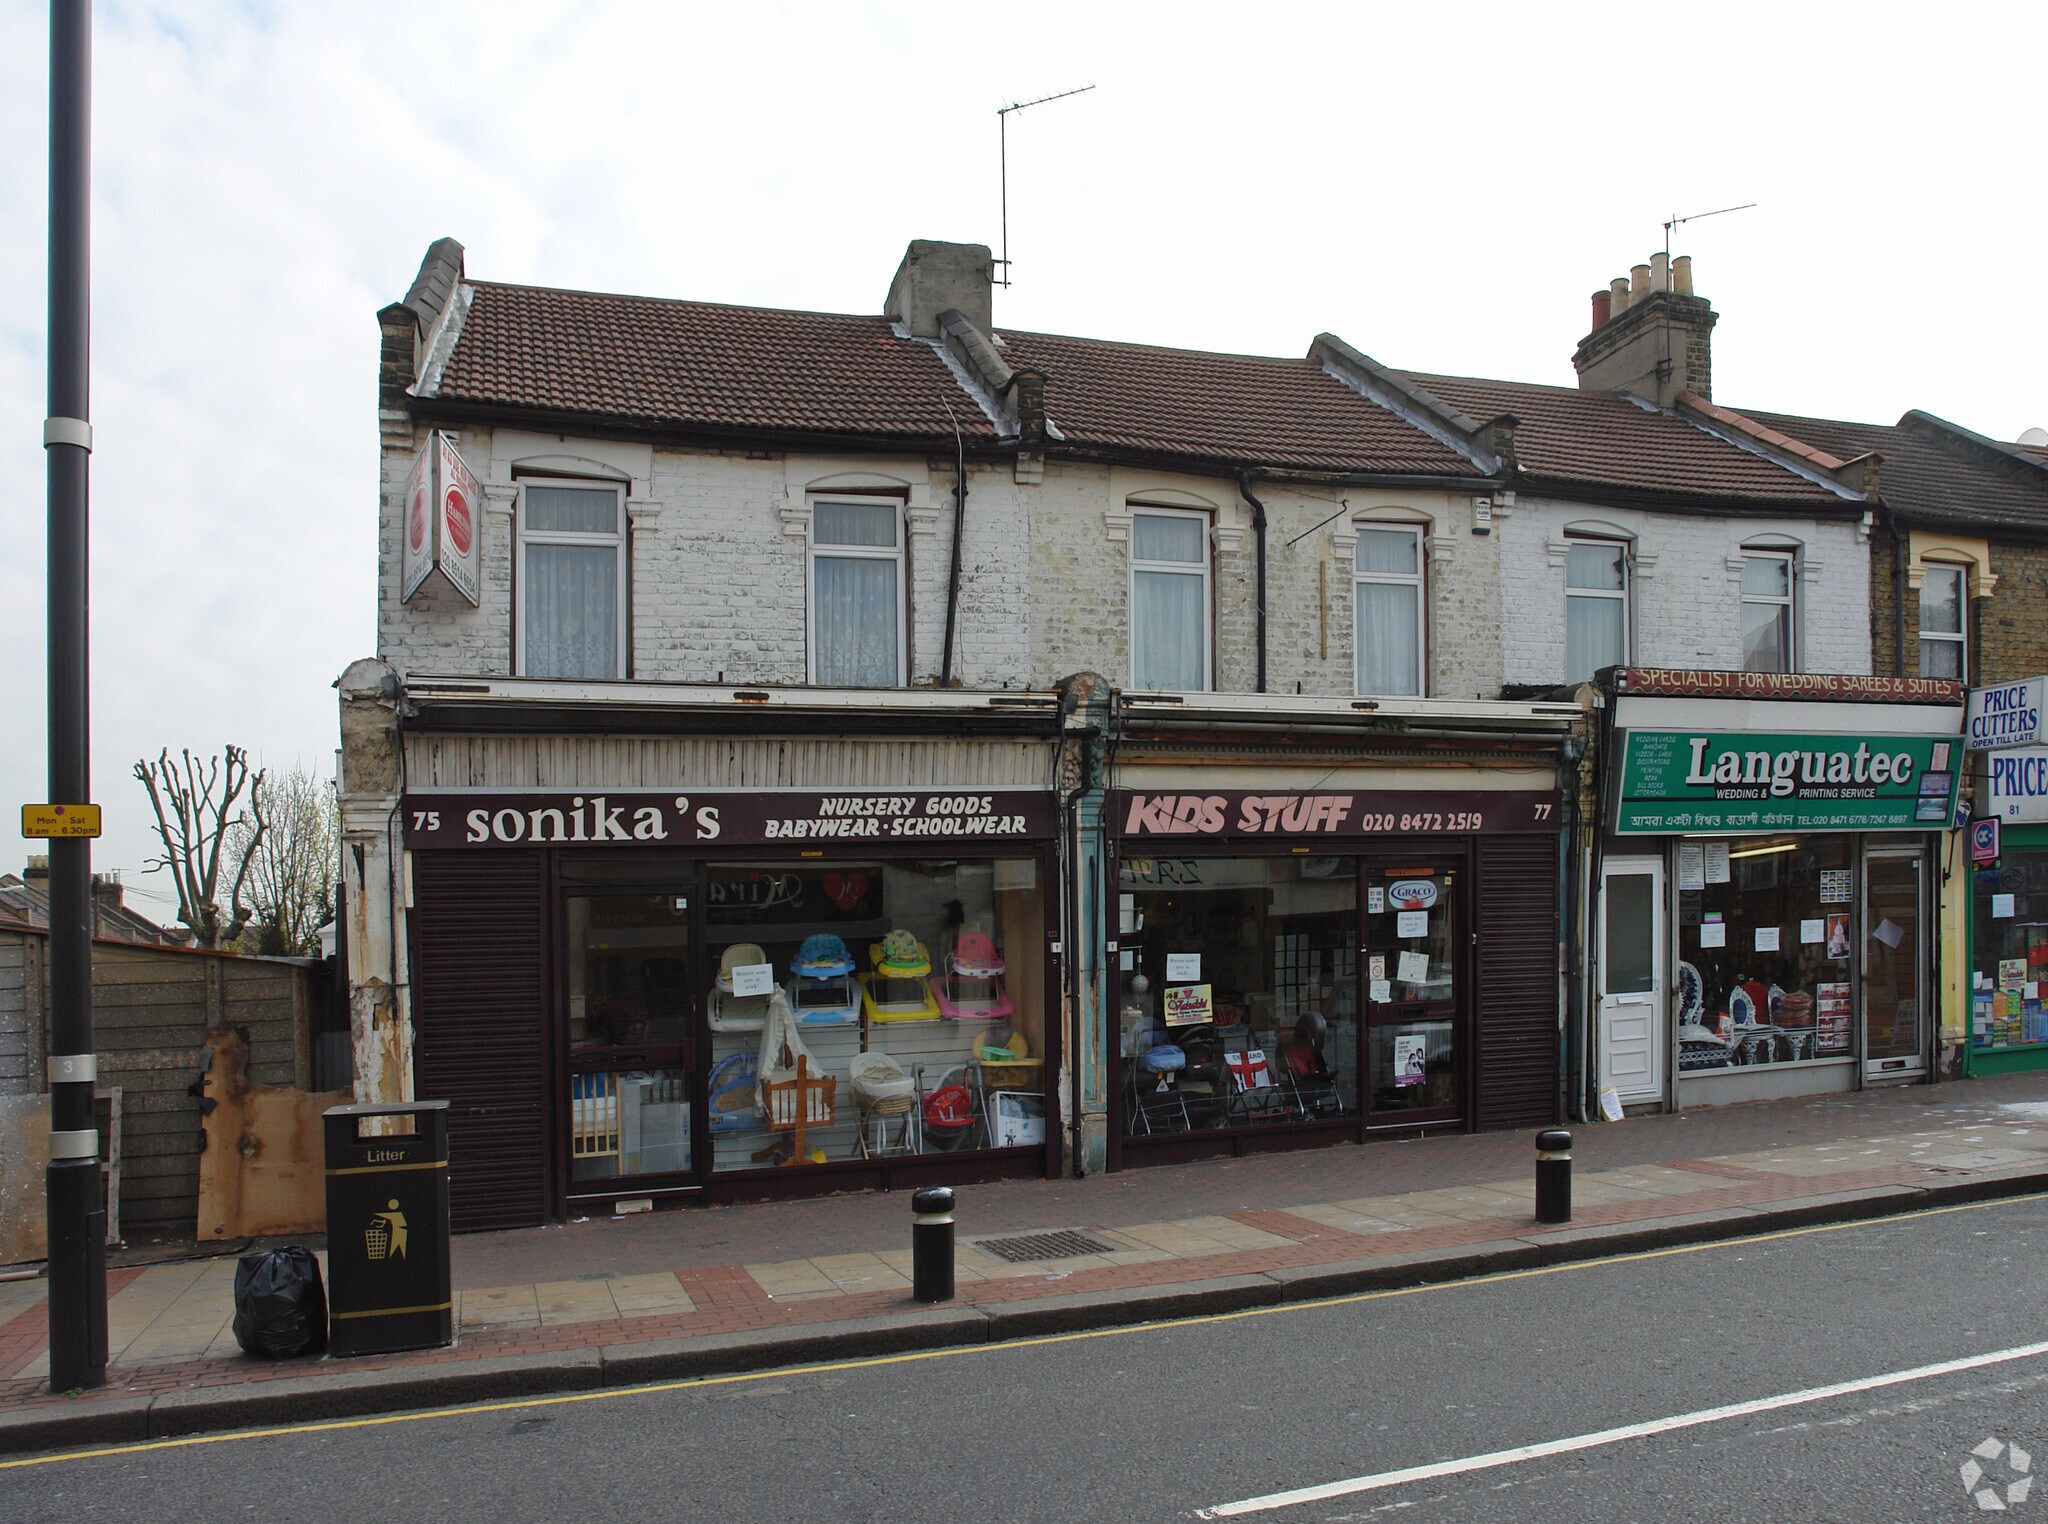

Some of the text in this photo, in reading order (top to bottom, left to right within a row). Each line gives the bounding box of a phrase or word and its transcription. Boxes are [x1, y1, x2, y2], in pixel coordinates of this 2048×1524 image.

[1640, 669, 1951, 694] SPECIALIST FOR WEDDING SAREES & SUITES
[1984, 686, 2027, 713] PRICE
[1972, 708, 2037, 738] CUTTERS
[1972, 732, 2034, 748] OPEN TILL LATE
[1686, 738, 1913, 796] Languatec
[1993, 757, 2048, 796] PRICE
[1716, 788, 1876, 799] WEDDING & PRINTING SERVICE
[819, 797, 992, 816] NURSERY GOODS
[1125, 796, 1353, 834] KIDS STUFF
[1534, 804, 1552, 820] 77
[2010, 805, 2020, 815] 81
[36, 816, 86, 825] Mon Sat
[413, 812, 440, 831] 75
[466, 797, 720, 843] sonika's
[1362, 813, 1482, 831] 020 8472 2519
[1830, 815, 1847, 825] 8471
[62, 827, 97, 835] 6.30pm
[1397, 888, 1431, 897] GRACO
[64, 1060, 73, 1073] 3
[367, 1150, 405, 1163] Litter
